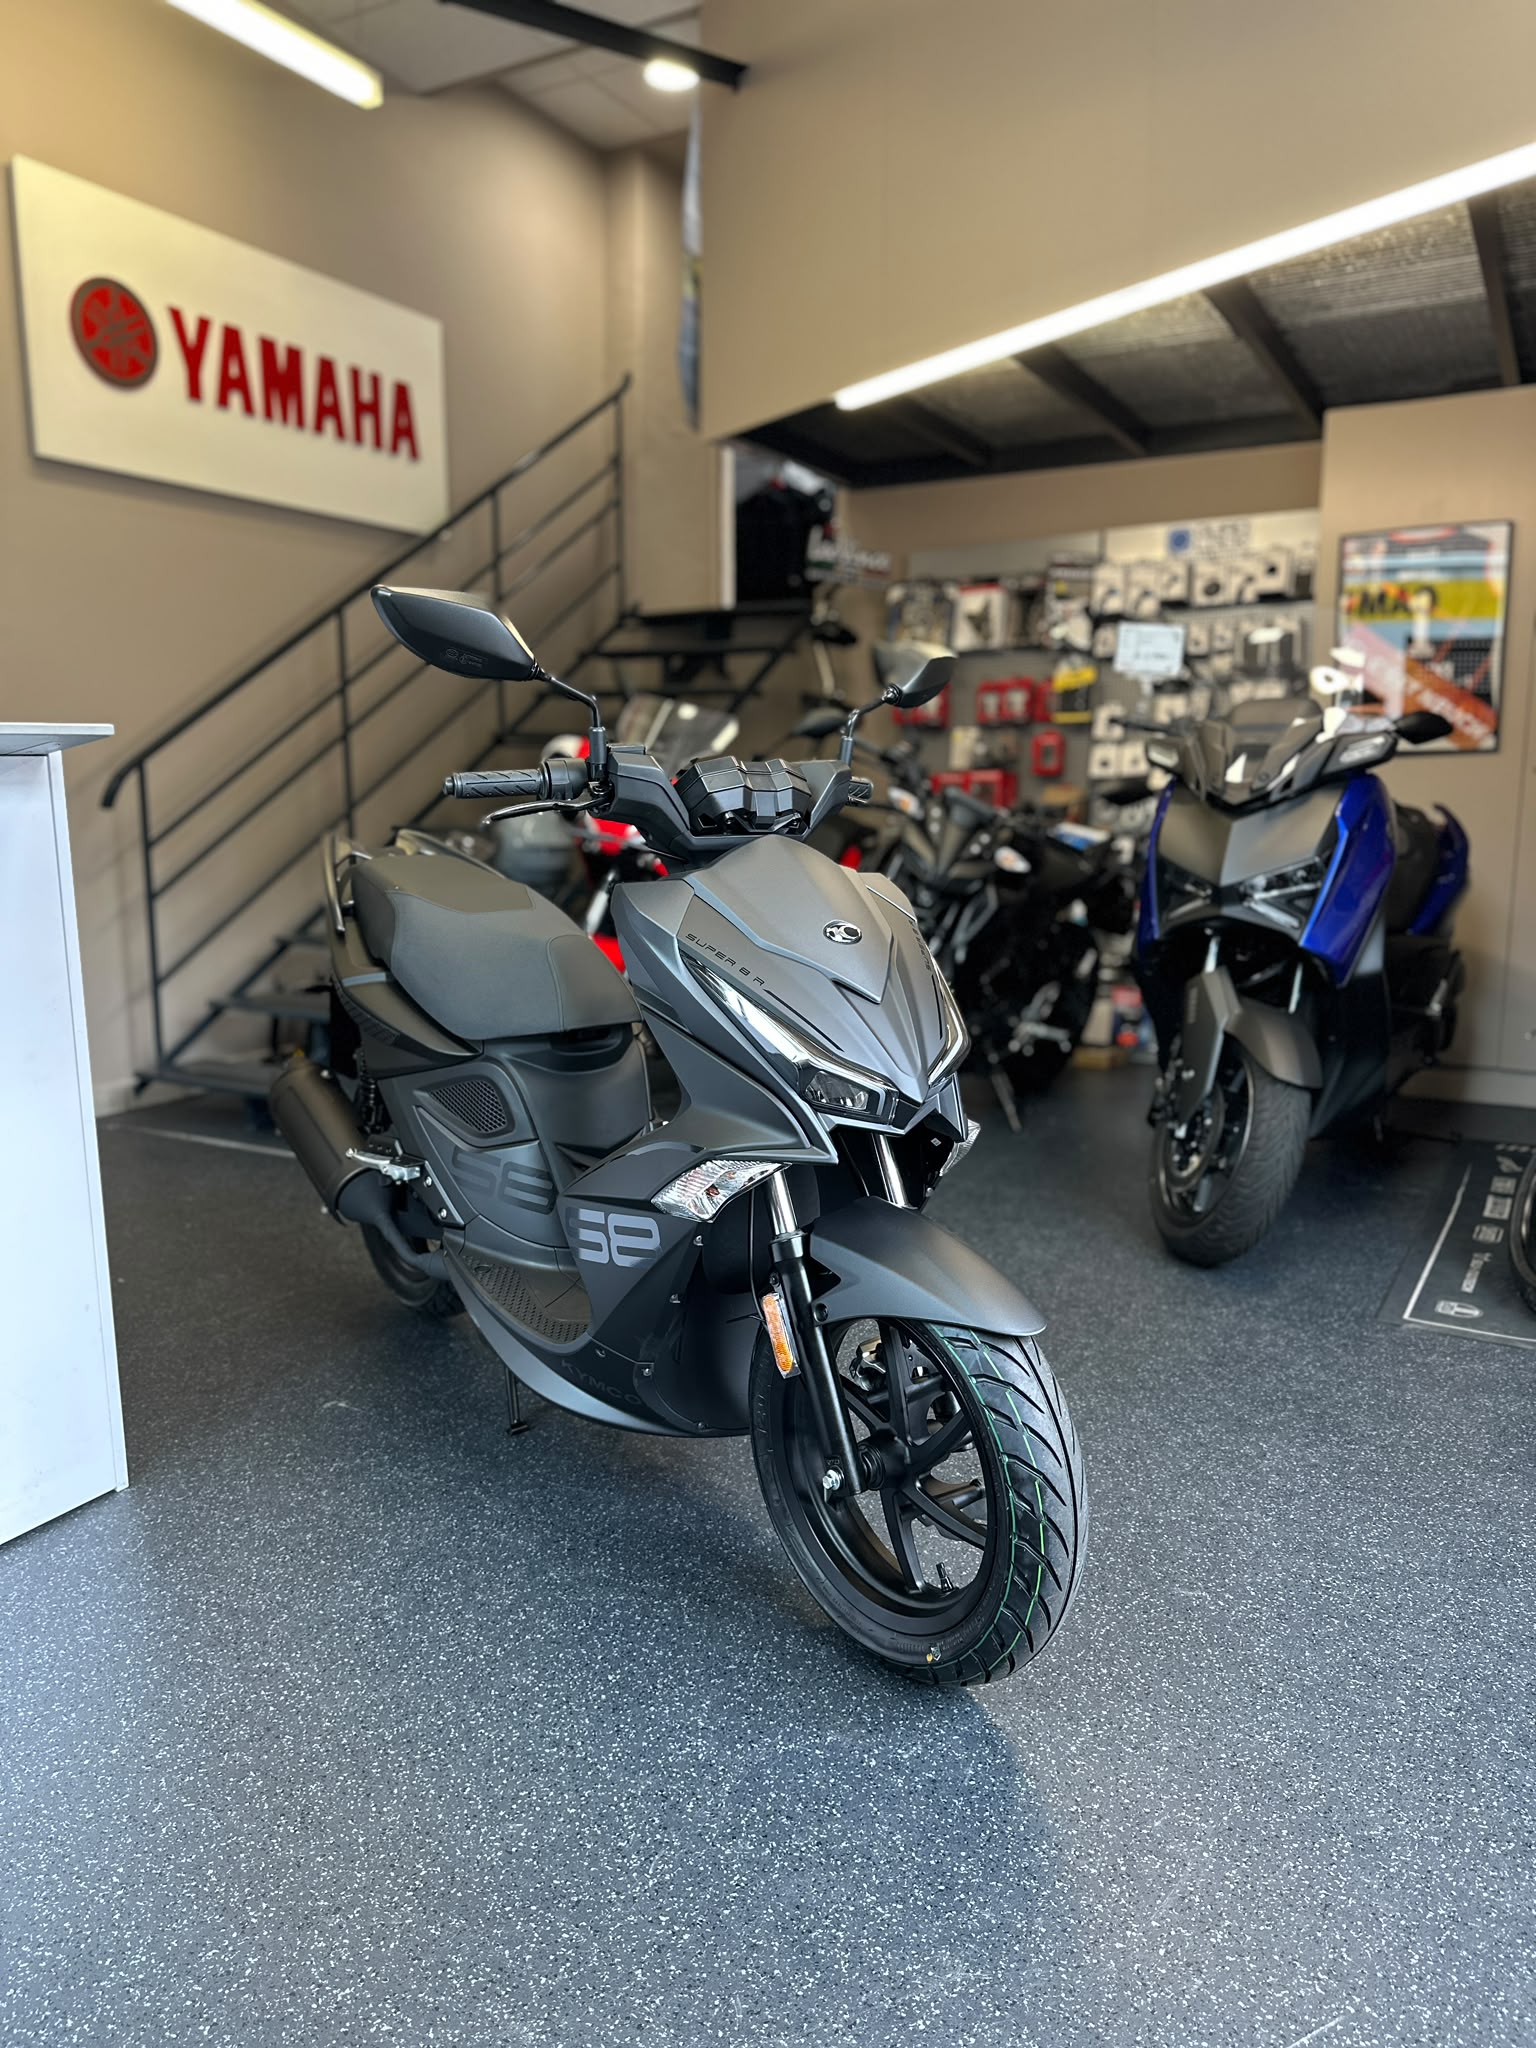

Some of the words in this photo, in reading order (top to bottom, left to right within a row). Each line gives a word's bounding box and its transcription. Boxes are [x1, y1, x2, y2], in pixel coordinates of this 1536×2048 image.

[167, 304, 421, 463] YAMAHA
[685, 933, 737, 967] SUPER
[738, 966, 751, 977] 8
[752, 976, 766, 987] R
[560, 1359, 643, 1405] KYMCO
